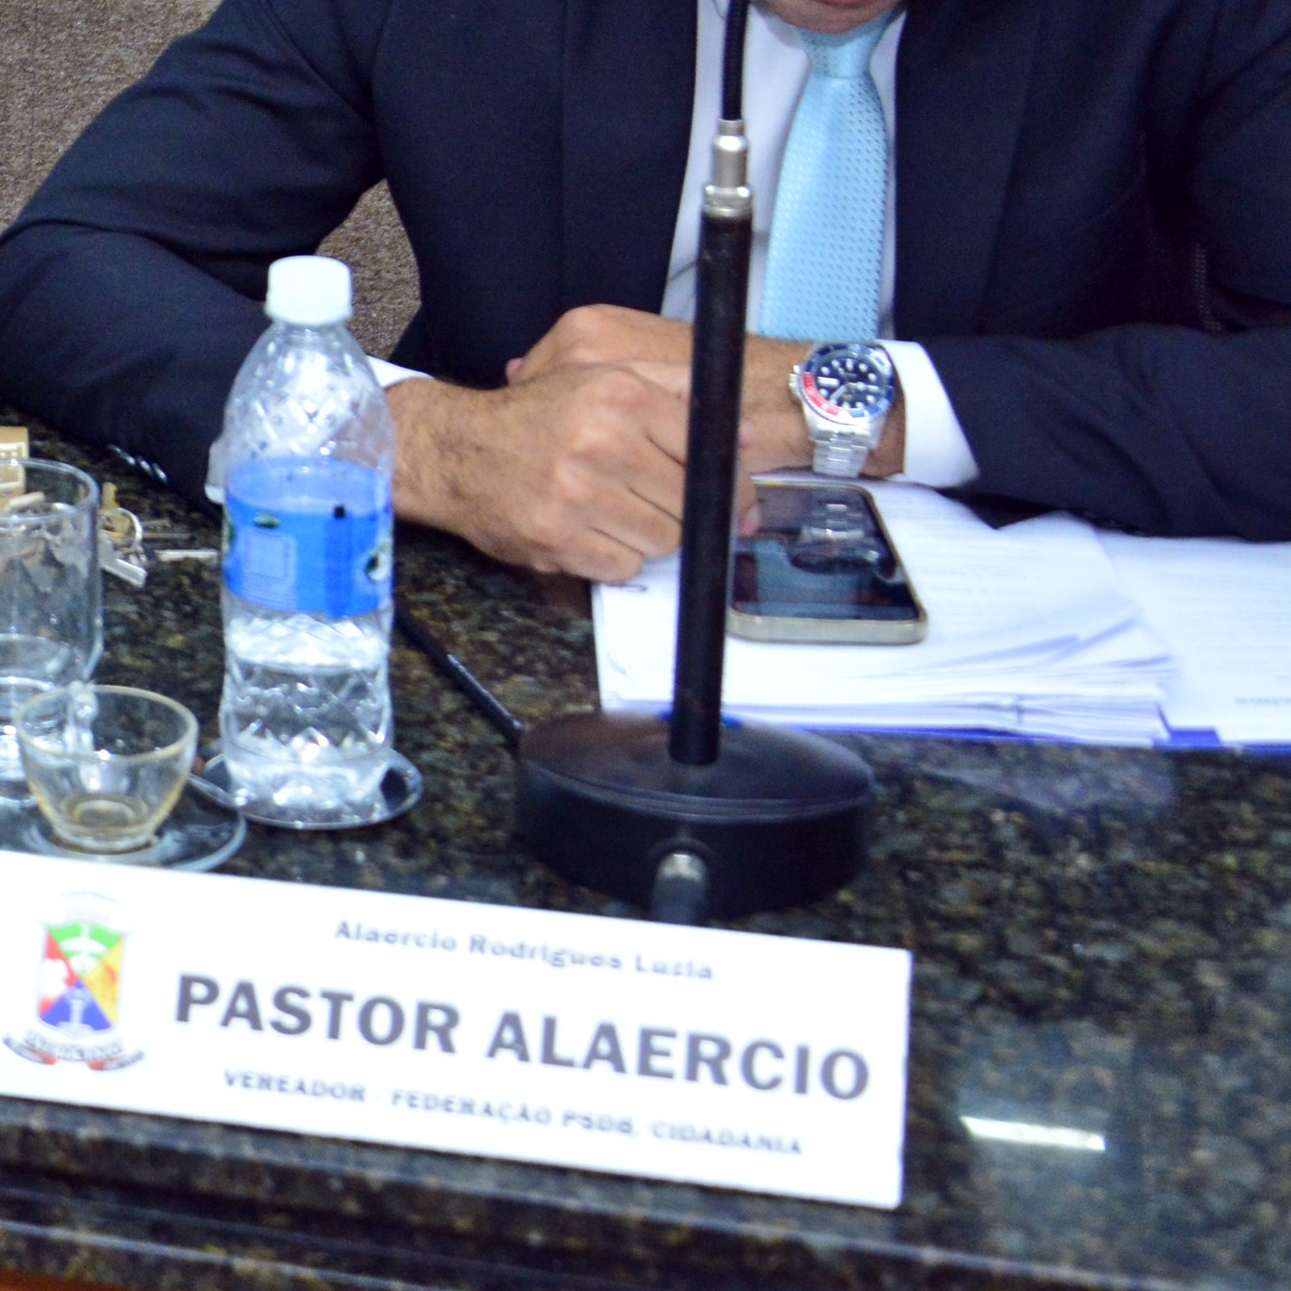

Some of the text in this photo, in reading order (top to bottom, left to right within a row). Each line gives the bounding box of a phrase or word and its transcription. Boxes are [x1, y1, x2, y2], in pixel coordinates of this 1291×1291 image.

[334, 920, 714, 981] Alaercio Rodrigues Luzia
[175, 972, 871, 1102] PASTOR ALAERCIO
[222, 1067, 367, 1103] VEREADOR
[391, 1088, 552, 1126] FEDERAÇÃO
[561, 1111, 804, 1156] PSDBCIDADANIA
